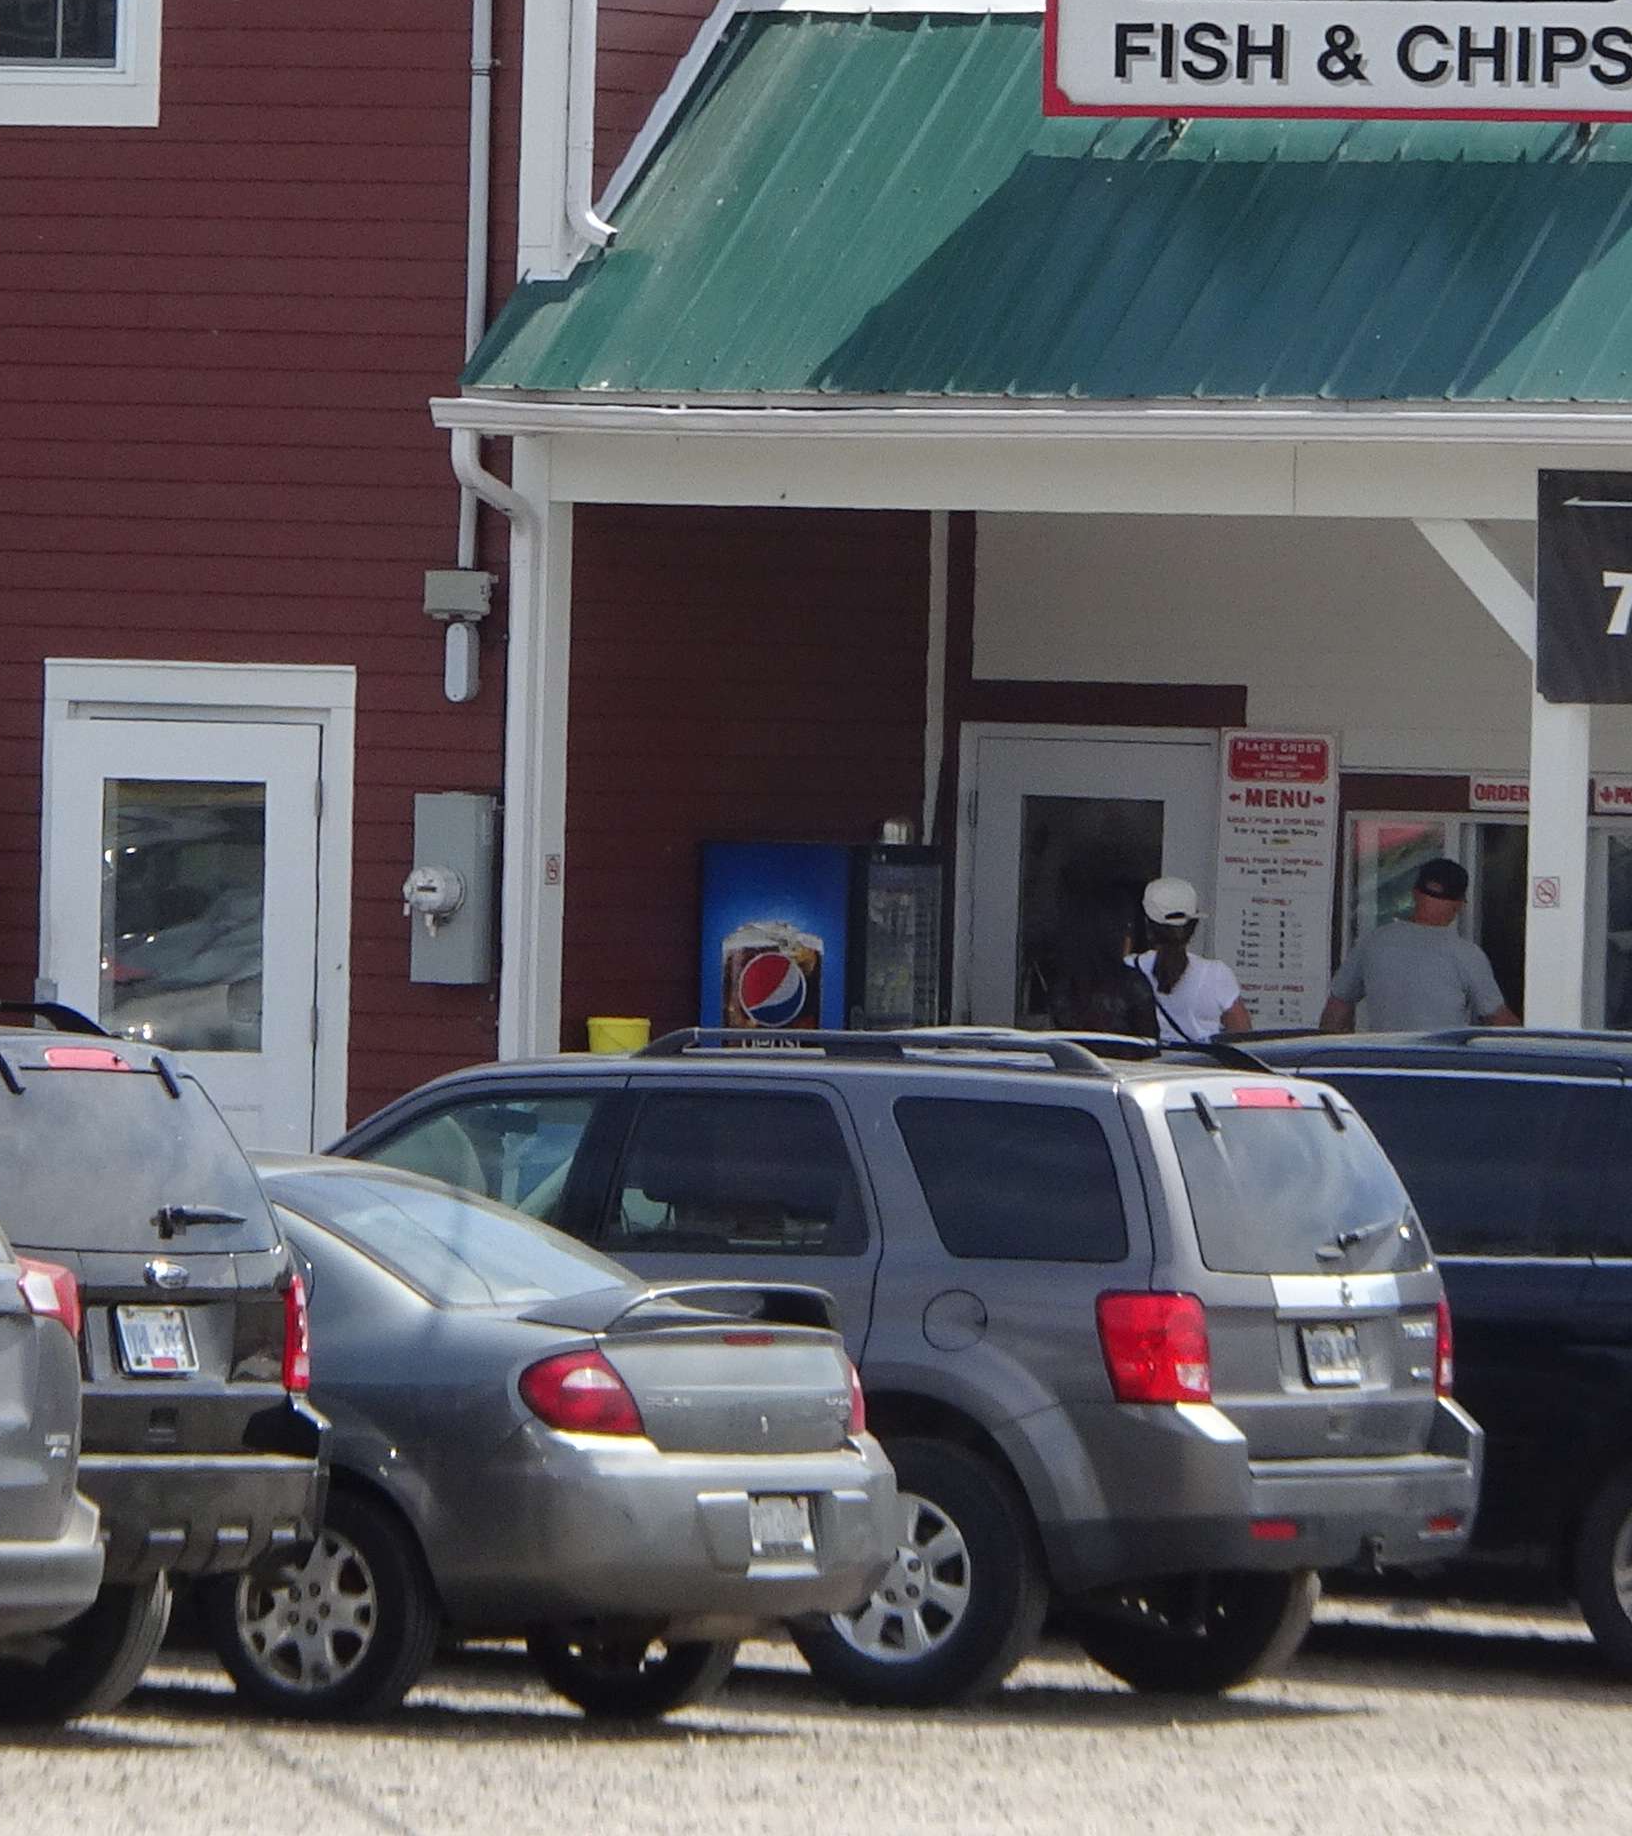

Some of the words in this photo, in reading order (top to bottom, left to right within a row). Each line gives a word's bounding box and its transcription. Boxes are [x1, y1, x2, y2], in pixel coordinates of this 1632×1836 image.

[1113, 22, 1290, 85] FISH
[1317, 24, 1372, 86] &
[1244, 787, 1311, 809] MENU
[1474, 783, 1530, 803] ORDER
